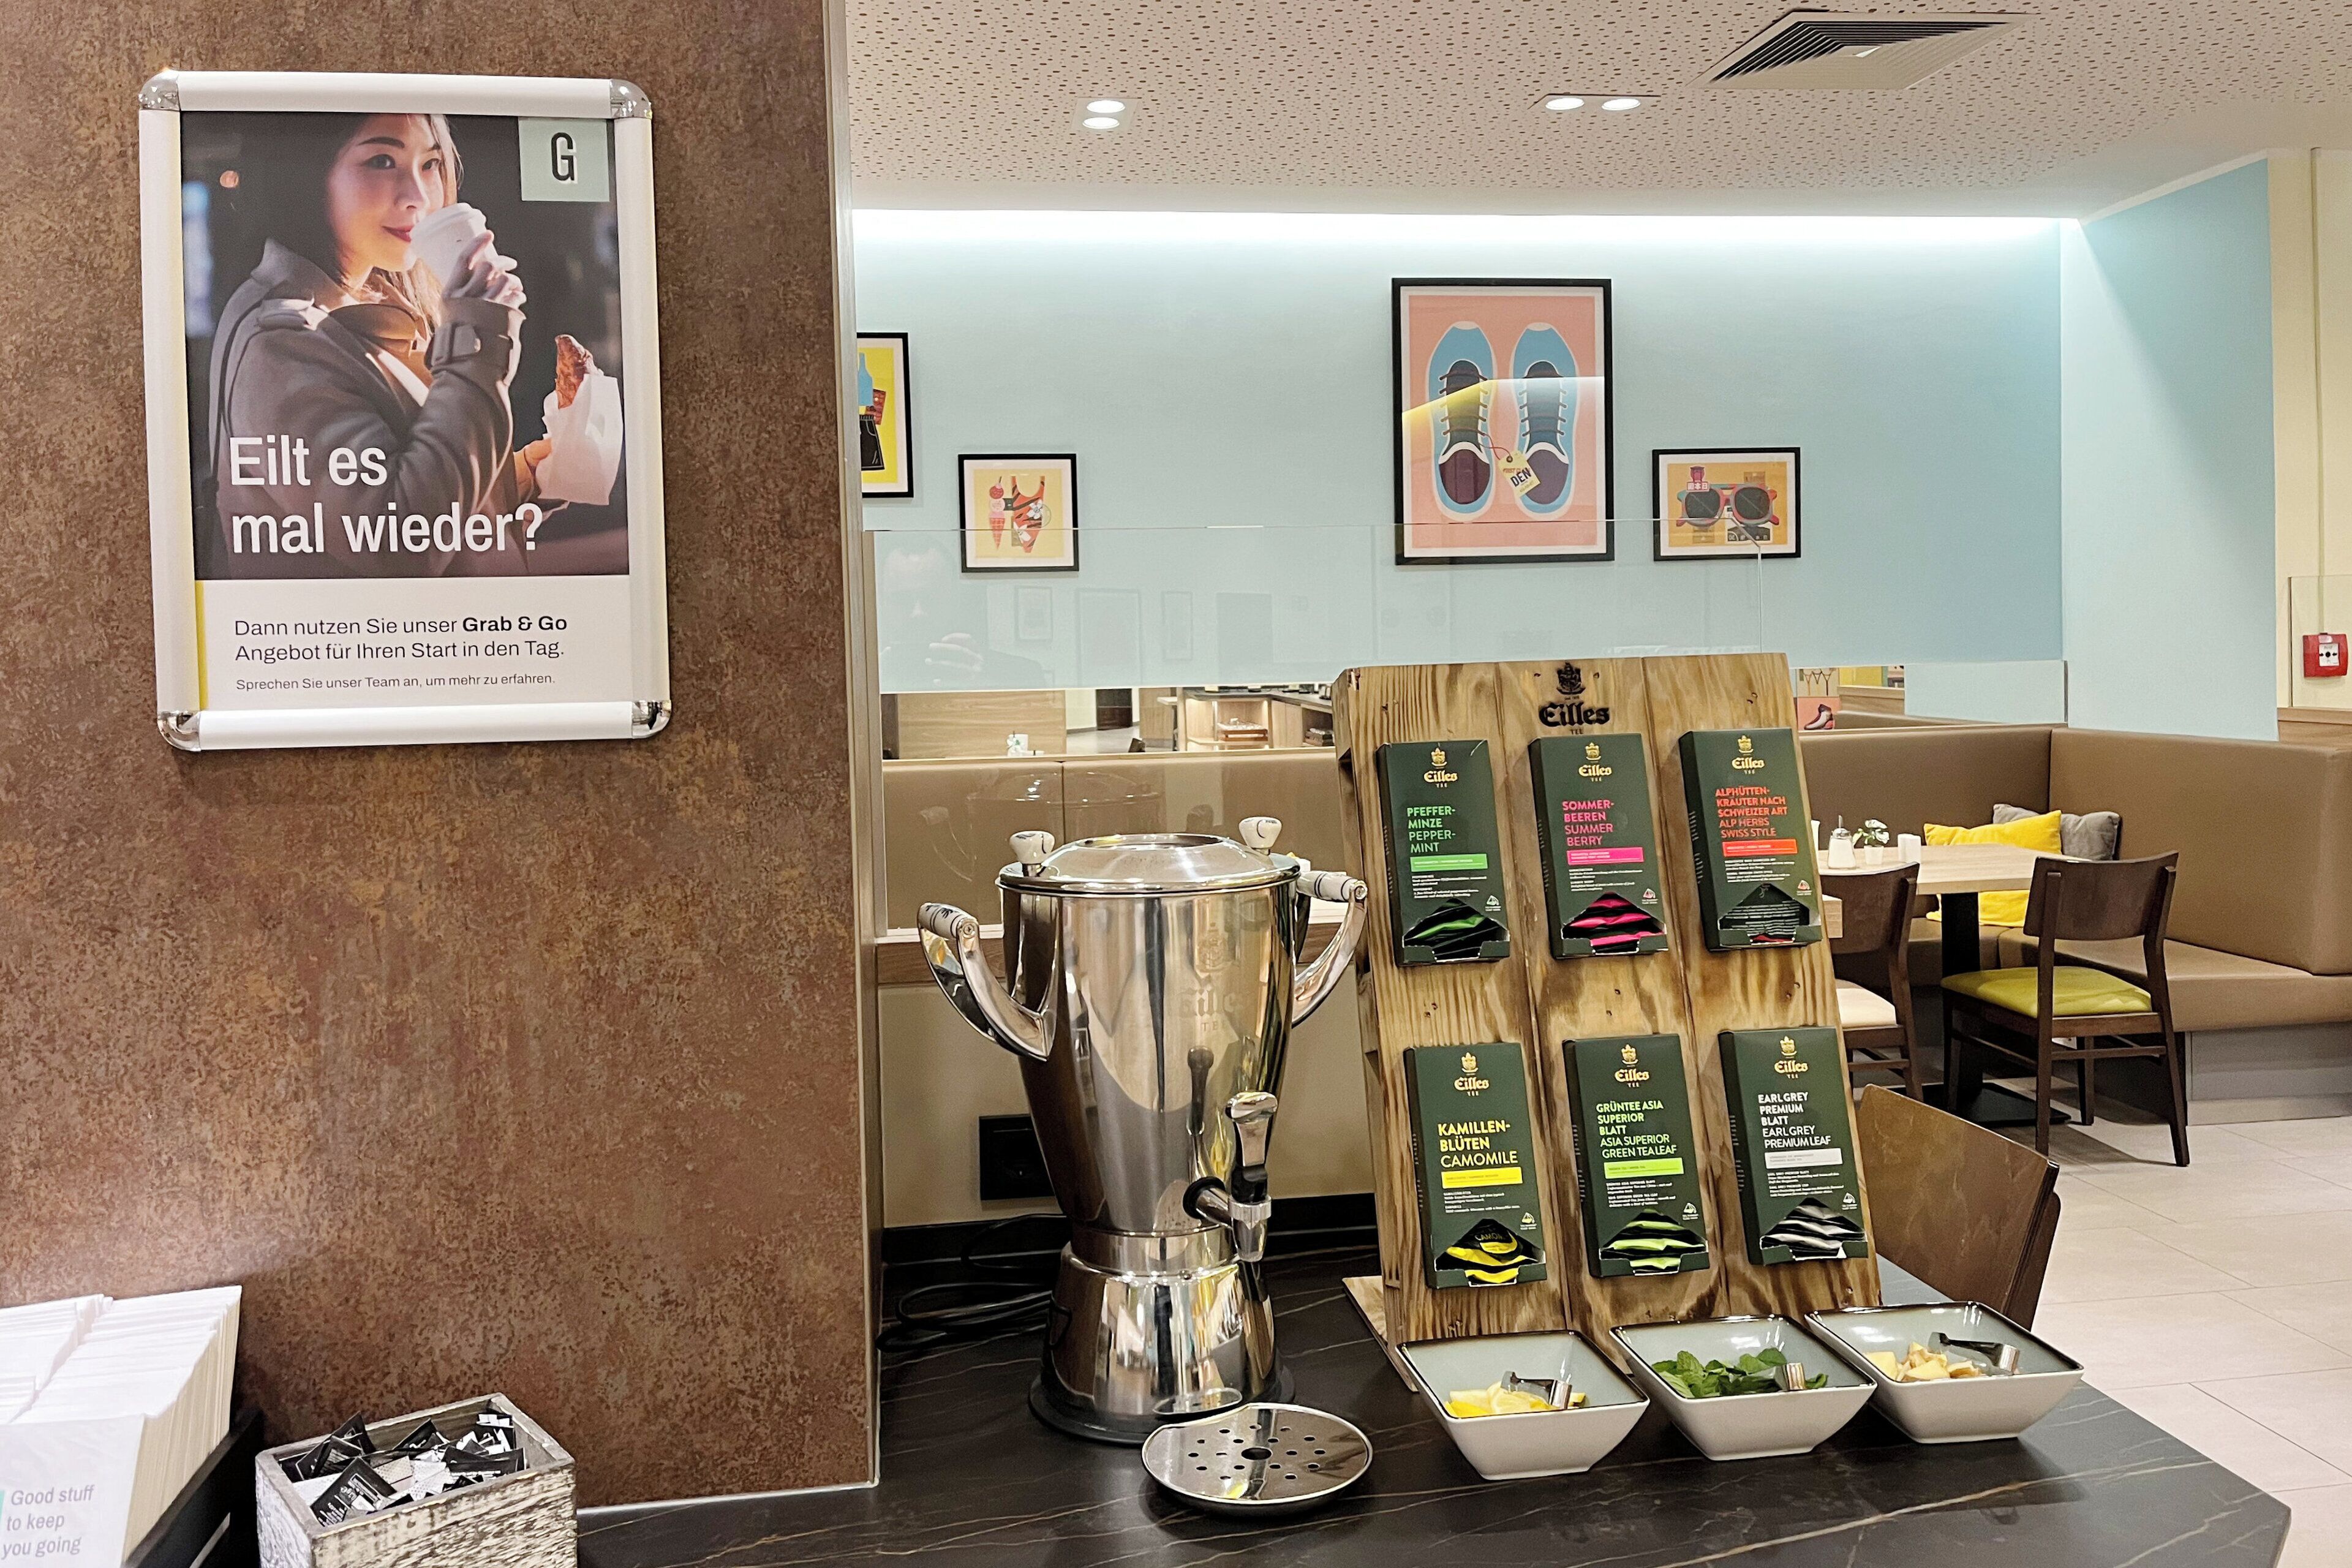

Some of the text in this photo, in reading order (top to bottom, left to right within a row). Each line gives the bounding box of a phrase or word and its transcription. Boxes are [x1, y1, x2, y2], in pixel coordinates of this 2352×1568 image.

[551, 132, 576, 183] G
[230, 434, 387, 486] Eilt es
[1510, 467, 1531, 487] DEN
[232, 502, 543, 552] mal wieder?
[235, 616, 567, 635] Dann nutzen Sie unser Grab & Go
[235, 641, 564, 663] Angebot für Ihren Start in den Tag.
[236, 673, 555, 692] Sprechen Sie unser Team an, um mehr zu erfahren.
[1538, 701, 1610, 727] Eilles
[1423, 770, 1458, 783] Eilles
[1562, 799, 1615, 810] SOMMER-
[1760, 796, 1786, 805] NACH
[1407, 805, 1456, 817] PFEFFER-
[1564, 811, 1606, 822] BEEREN
[1718, 807, 1770, 818] SCHWEIZER
[1408, 818, 1442, 829] MINZE
[1564, 823, 1613, 834] SUMMER
[1719, 817, 1770, 828] ALP HERBS
[1409, 830, 1456, 841] PEPPER-
[1721, 827, 1776, 838] SWISS STYLE
[1567, 836, 1602, 846] BERRY
[1411, 842, 1439, 853] MINT
[1758, 1092, 1808, 1103] EARL GREY
[1596, 1100, 1664, 1113] GRÜNTEE ASIA
[1759, 1103, 1804, 1115] PREMIUM
[1597, 1112, 1644, 1125] SUPERIOR
[1761, 1116, 1789, 1126] BLATT
[1438, 1120, 1510, 1136] KAMILLEN-
[1599, 1125, 1627, 1136] BLATT
[1762, 1125, 1815, 1137] EARL GREY
[1439, 1135, 1490, 1152] BLÜTEN
[1600, 1134, 1670, 1147] ASIA SUPERIOR
[1764, 1136, 1831, 1148] PREMIUM LEAF
[1602, 1147, 1636, 1158] GREEN
[1441, 1150, 1518, 1168] CAMOMILE
[11, 1485, 95, 1506] Good stuff
[7, 1513, 65, 1531] to keep
[1, 1536, 82, 1560] you going
